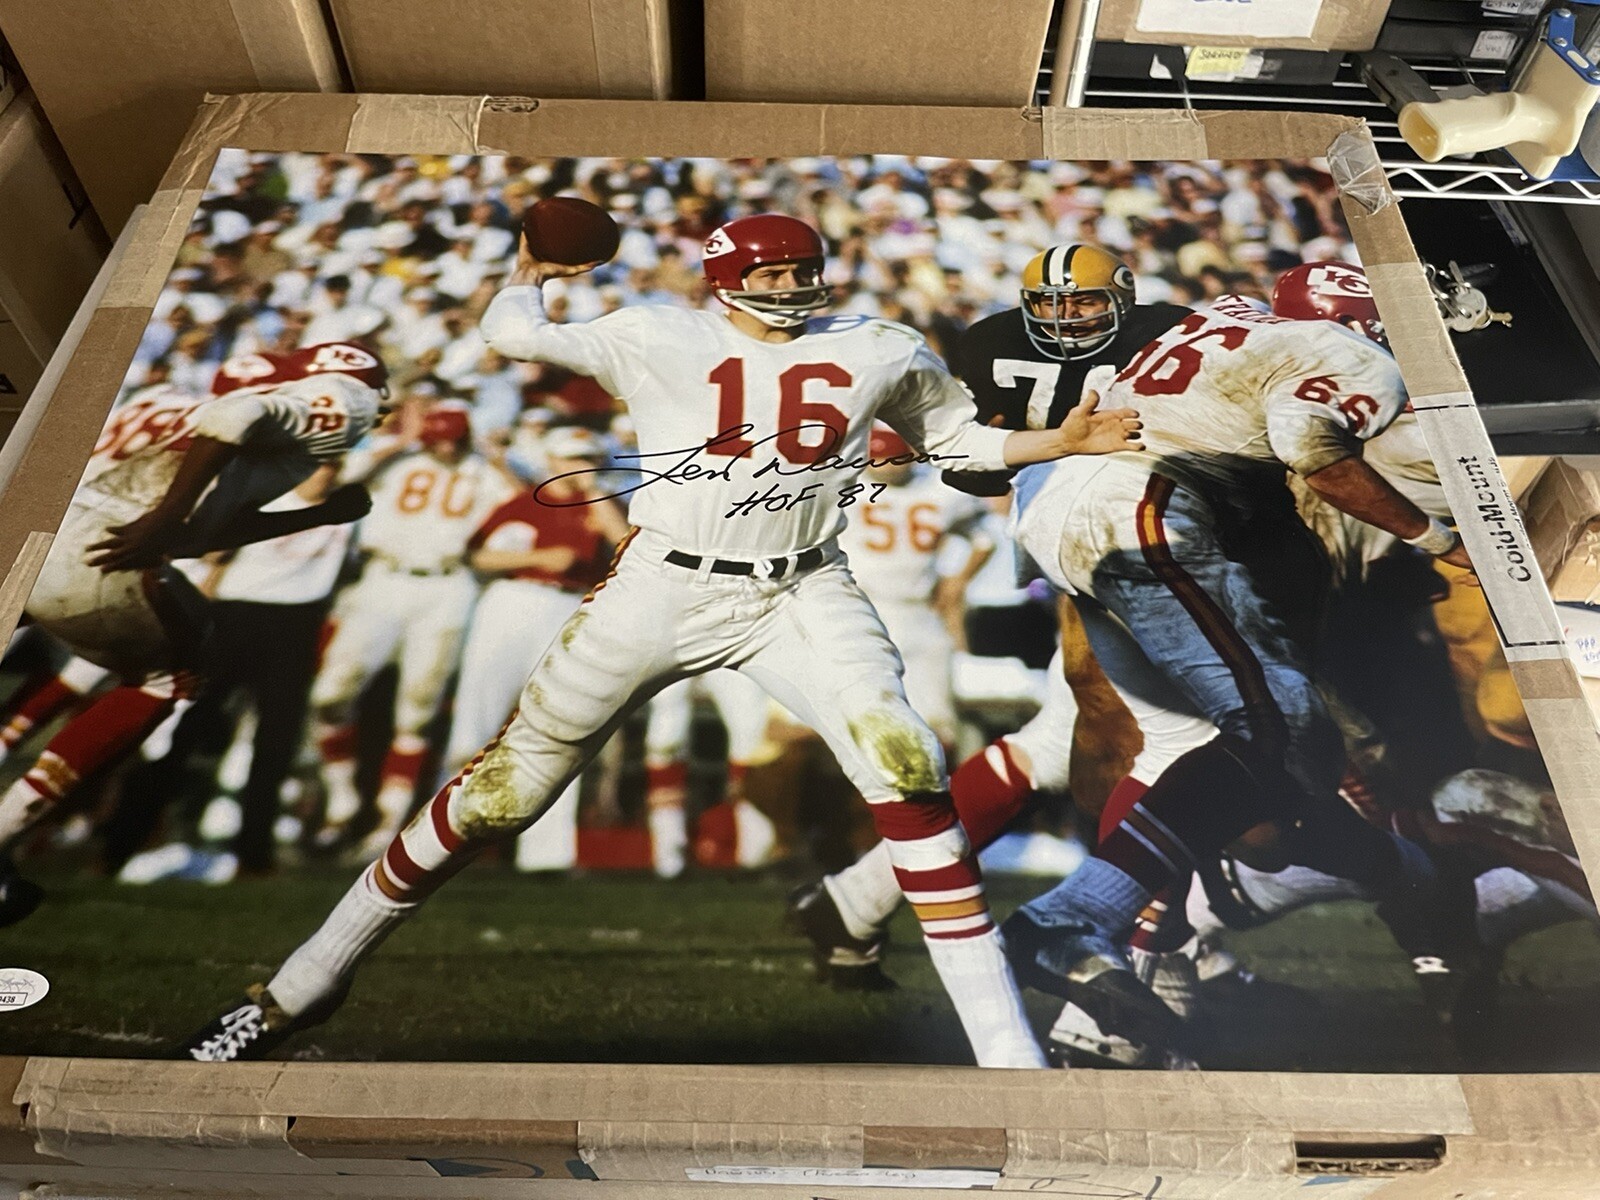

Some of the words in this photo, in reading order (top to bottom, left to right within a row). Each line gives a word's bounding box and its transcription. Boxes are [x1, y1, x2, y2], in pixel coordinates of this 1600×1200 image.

[706, 357, 853, 465] 16
[724, 483, 824, 519] HOF
[860, 502, 943, 553] 56
